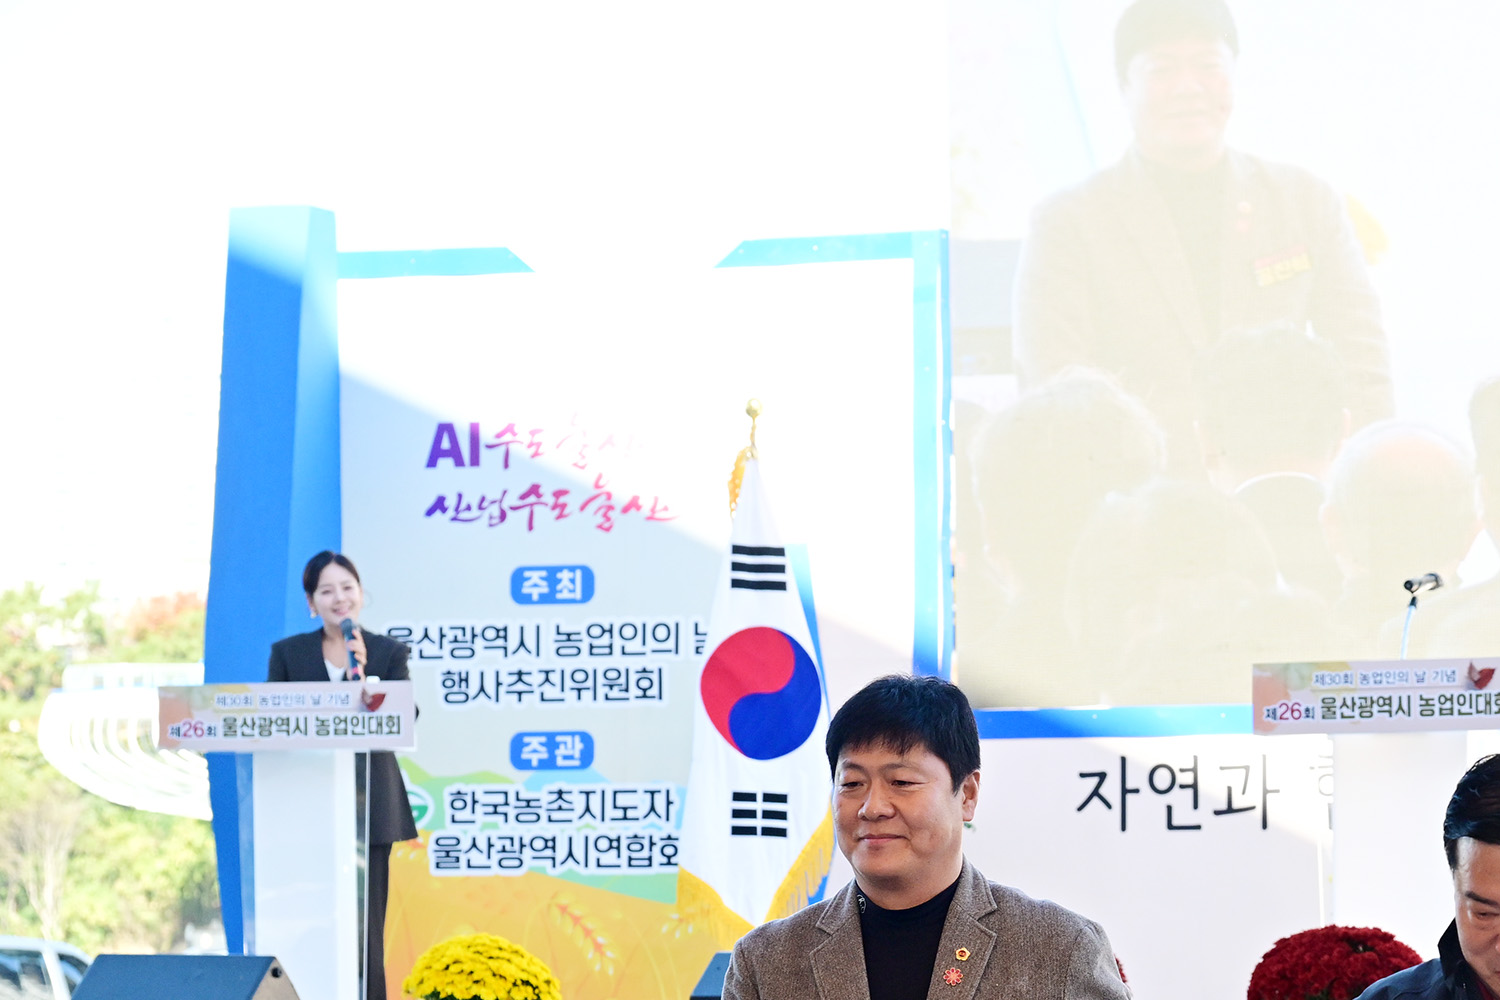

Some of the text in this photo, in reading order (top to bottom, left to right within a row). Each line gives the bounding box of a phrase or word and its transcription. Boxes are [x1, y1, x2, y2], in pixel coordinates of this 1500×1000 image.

[521, 568, 583, 602] 주최
[554, 621, 680, 658] 농업인의
[441, 666, 664, 704] 행사추진위원회
[1313, 669, 1457, 686] 제30회 농업인의 날 기념
[1264, 702, 1315, 721] 제26회
[1320, 694, 1411, 720] 울산광역시
[169, 713, 401, 738] 제26회 울산광역시 농업인대회
[520, 734, 584, 768] 주관
[449, 788, 674, 824] 한국농촌지도자
[1076, 754, 1281, 832] 자연과
